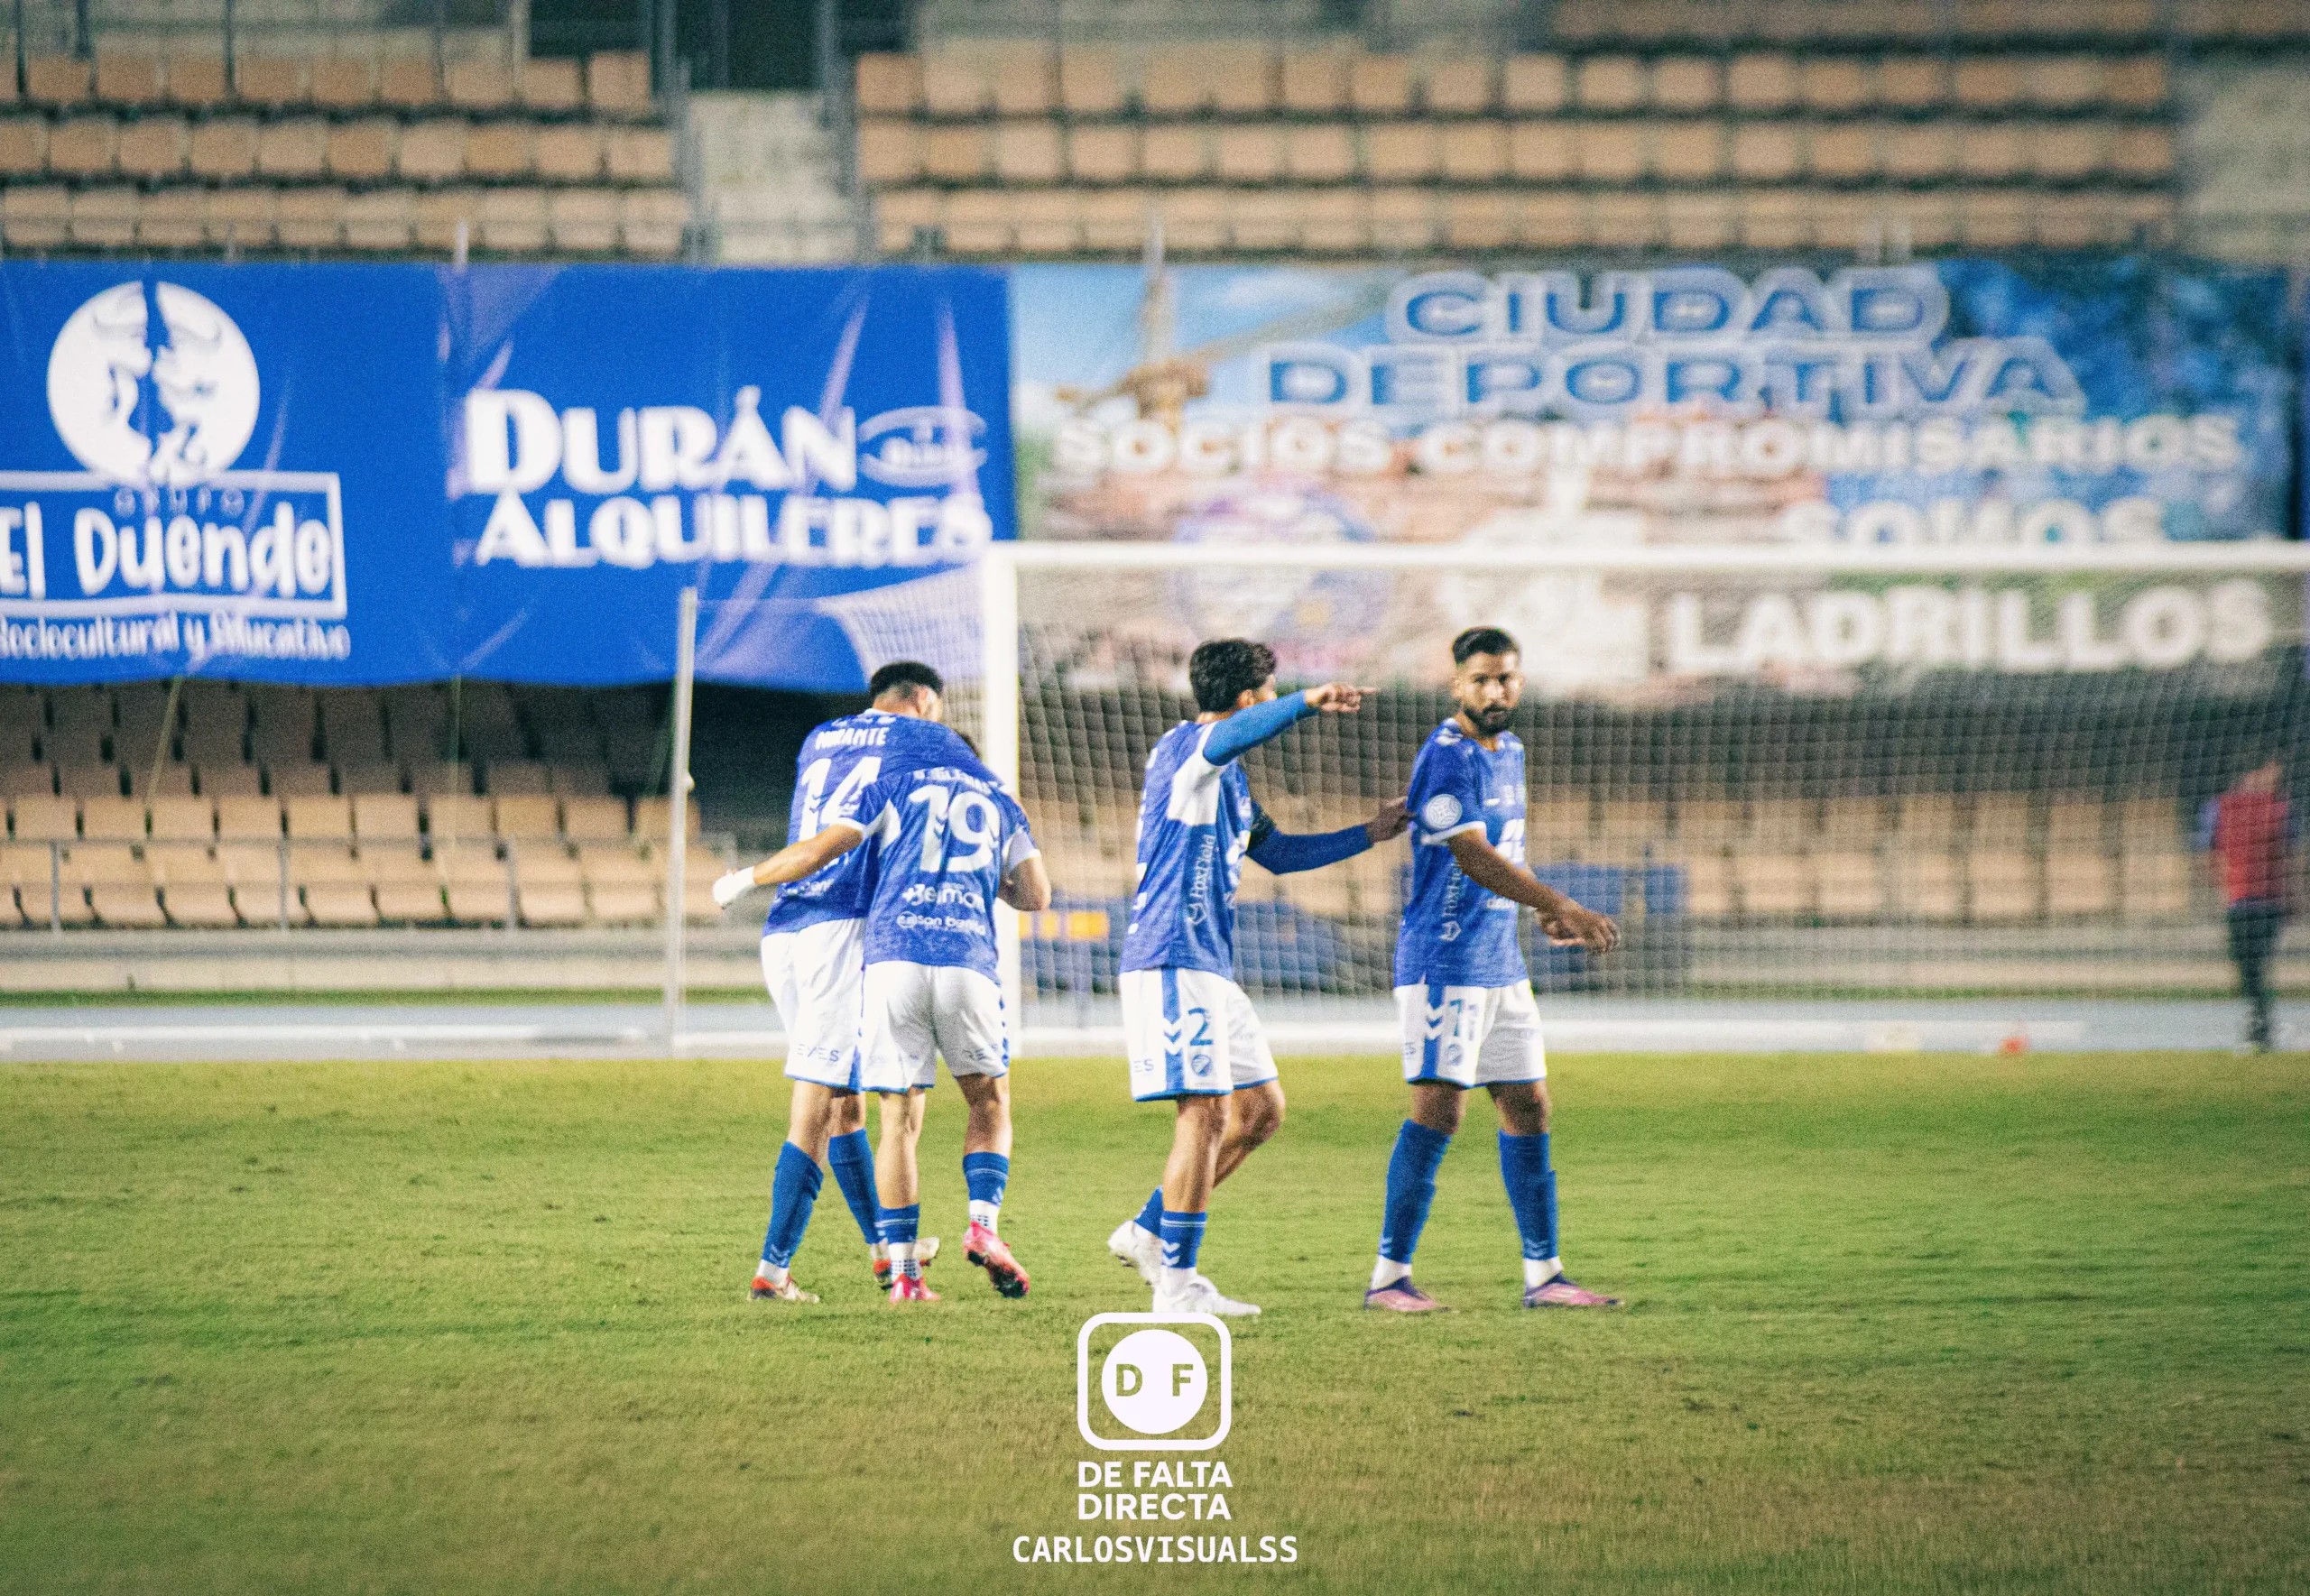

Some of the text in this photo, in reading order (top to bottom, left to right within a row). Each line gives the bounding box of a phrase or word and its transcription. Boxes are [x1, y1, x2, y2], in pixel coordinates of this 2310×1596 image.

[1387, 265, 1949, 348] CIUDAD
[1263, 338, 2086, 417] DEPORTIVA
[1057, 416, 1392, 475] SOCIOS
[74, 501, 332, 597] Duende
[476, 490, 993, 568] ALQUILERES
[1669, 578, 2272, 673] LADRILLOS
[799, 756, 882, 841] 14
[909, 785, 1001, 872] 19
[1188, 1007, 1213, 1046] 2
